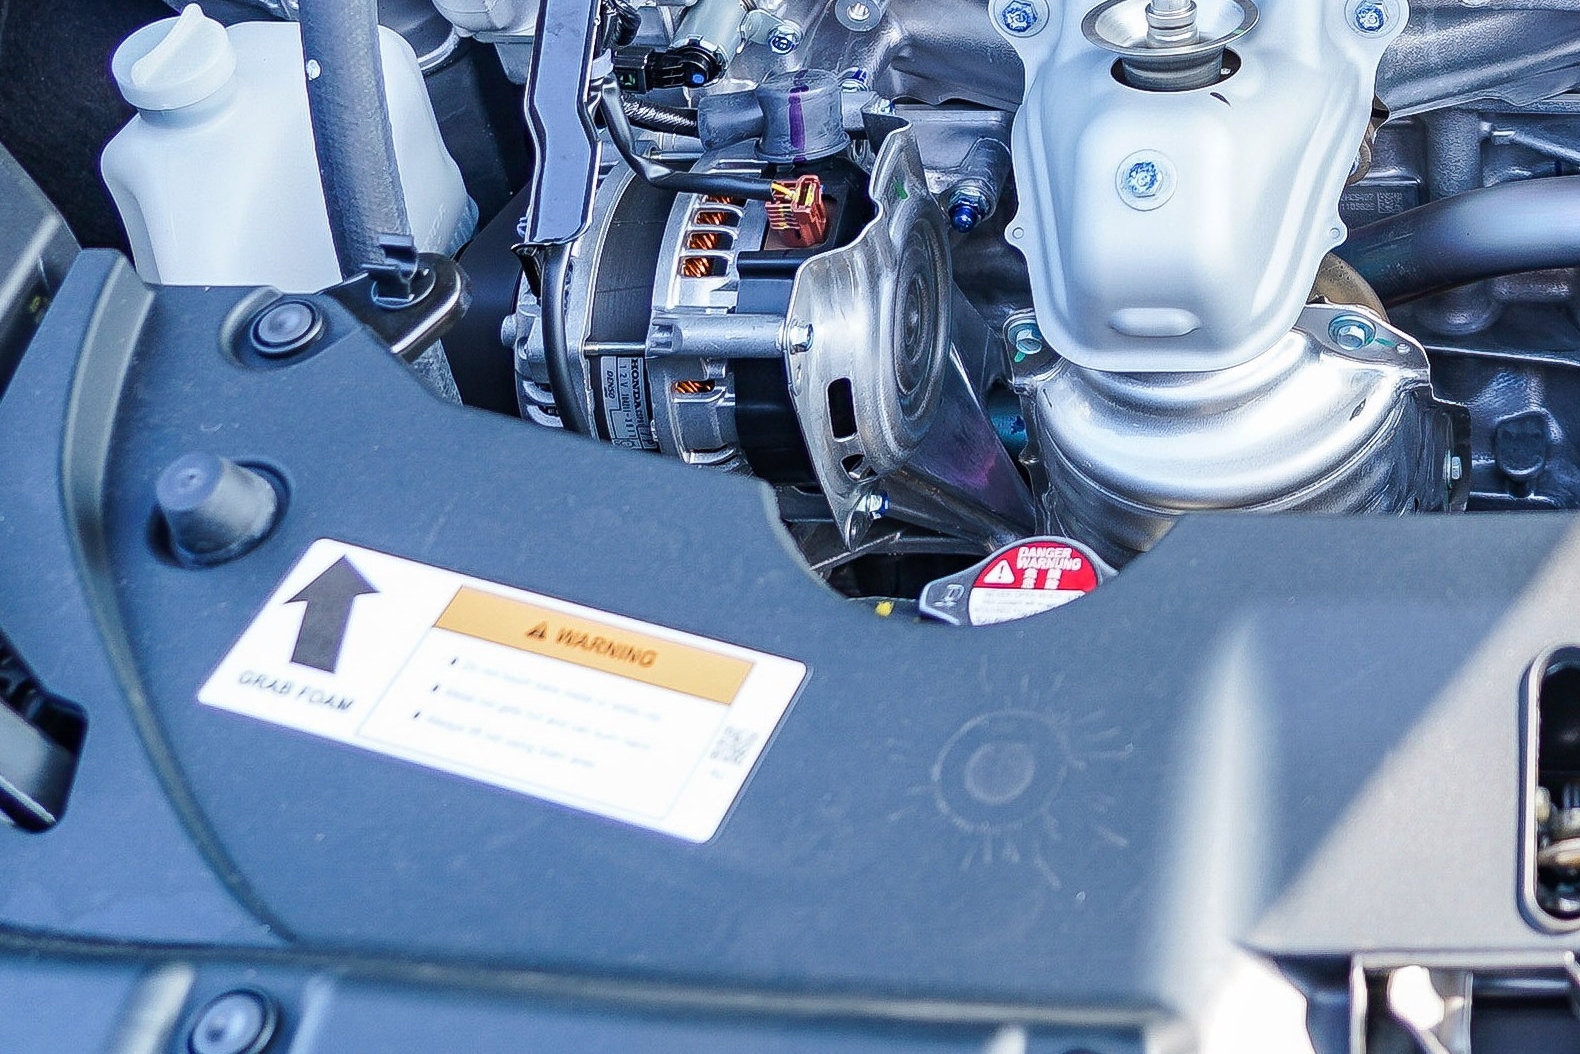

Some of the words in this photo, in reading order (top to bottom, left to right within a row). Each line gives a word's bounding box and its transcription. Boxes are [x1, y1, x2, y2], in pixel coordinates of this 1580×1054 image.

[606, 370, 616, 399] DENSO
[631, 359, 643, 411] HONDA
[1018, 546, 1073, 558] DANGER
[556, 626, 658, 668] WARNING
[238, 670, 293, 695] GRAB
[298, 685, 355, 711] FOAM
